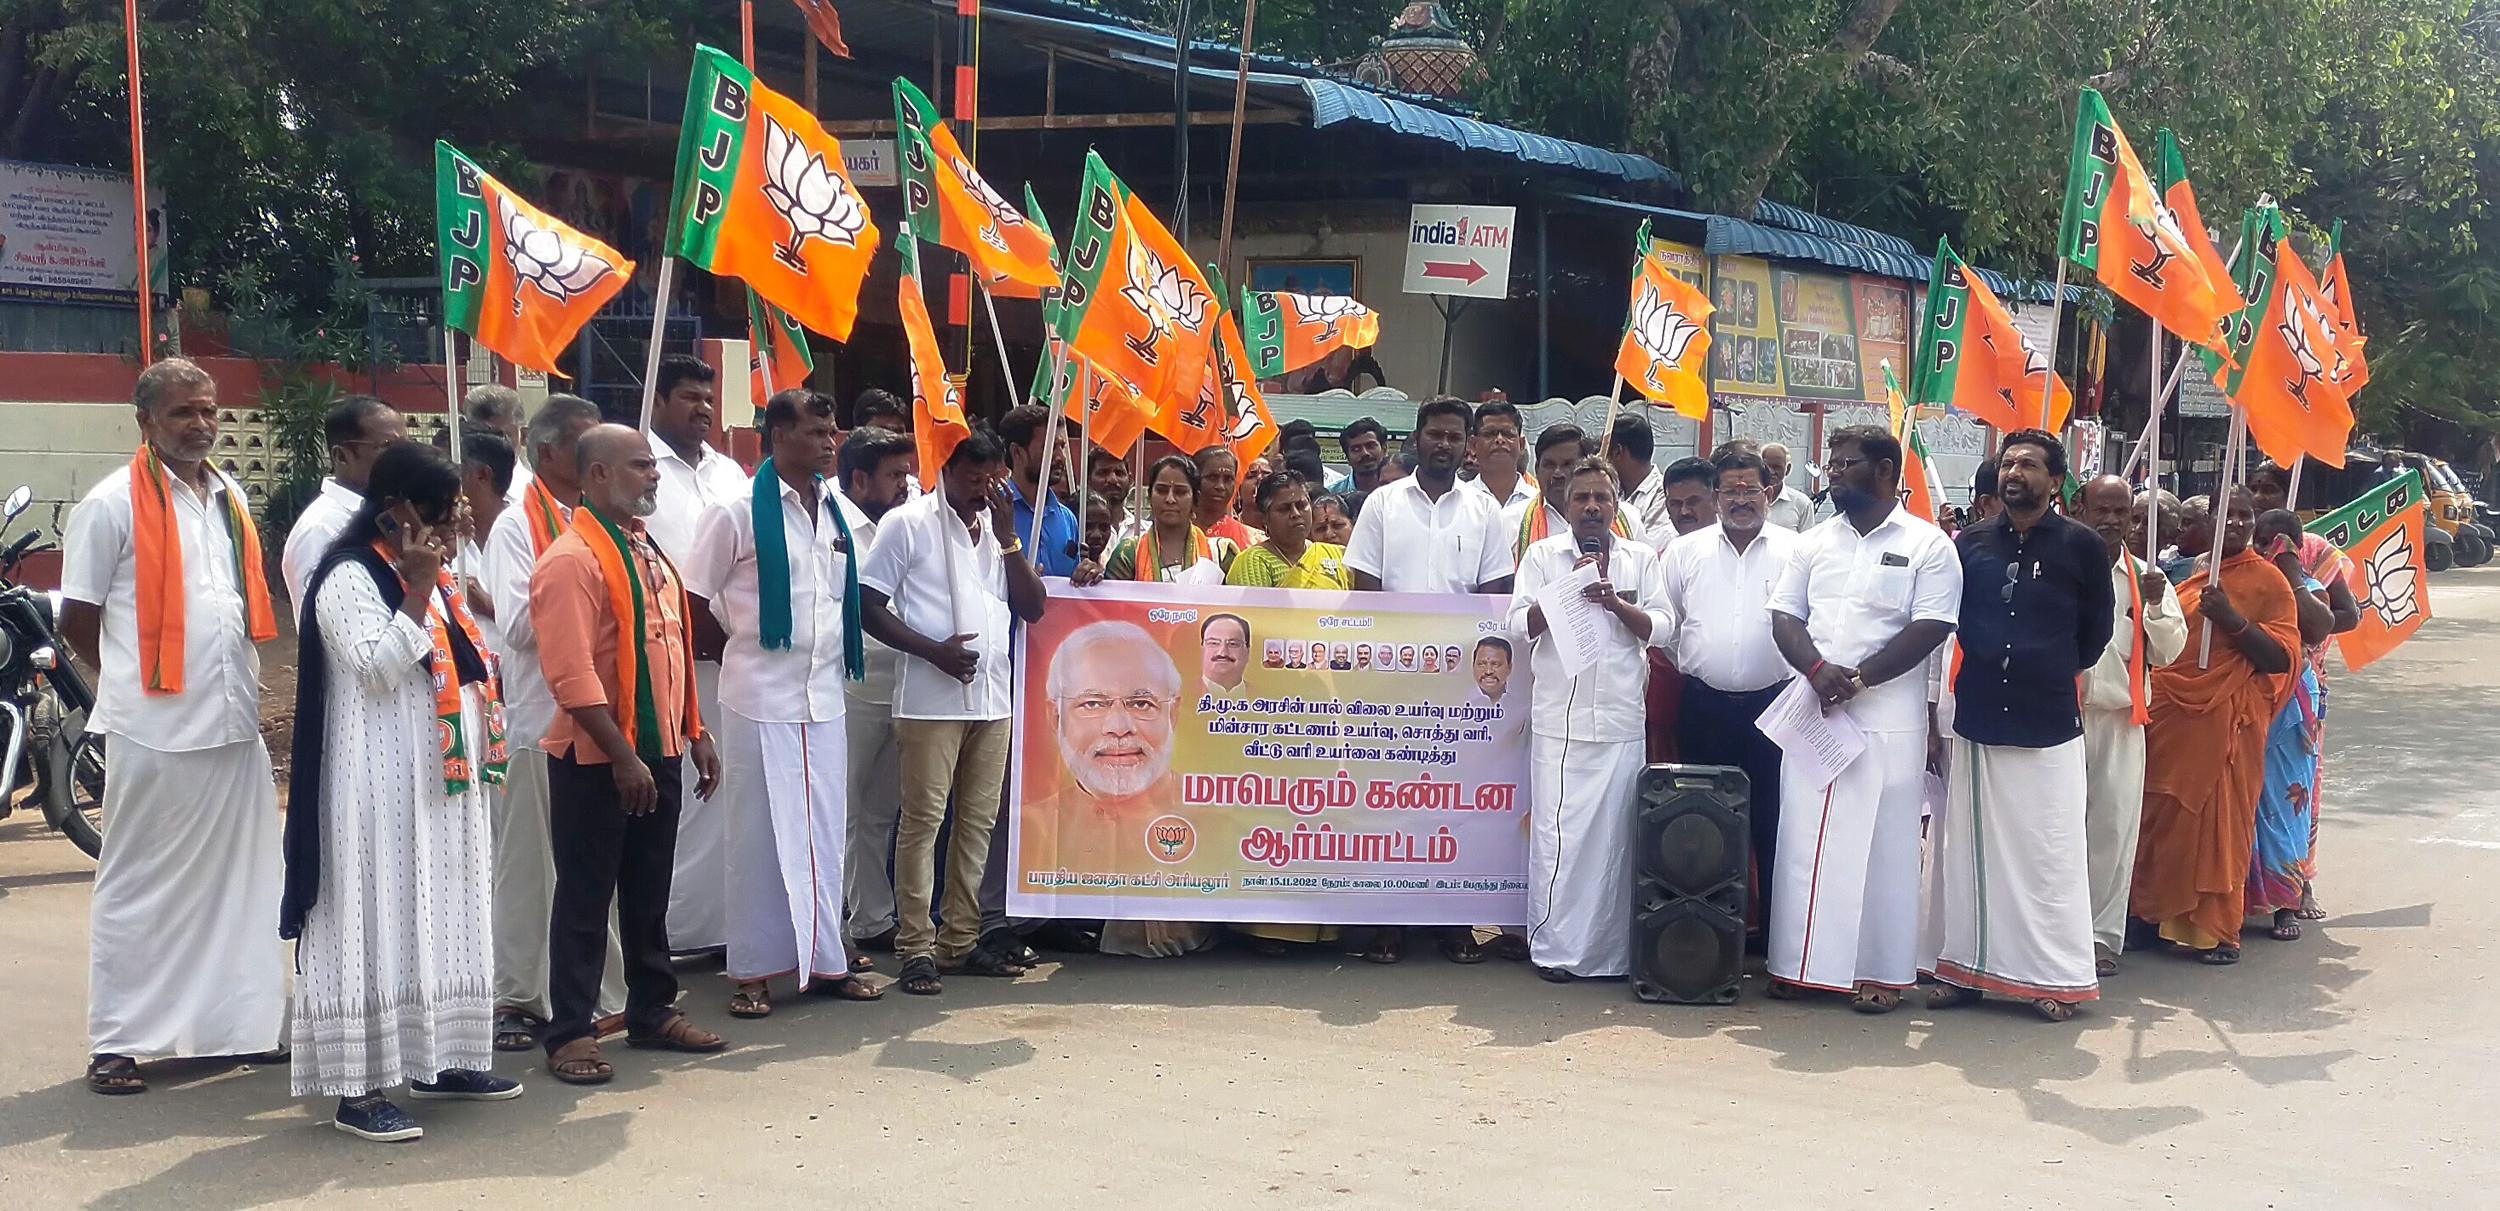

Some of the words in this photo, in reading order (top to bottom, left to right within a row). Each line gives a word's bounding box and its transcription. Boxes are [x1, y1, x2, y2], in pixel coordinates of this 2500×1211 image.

[692, 71, 748, 225] BJP
[844, 149, 880, 171] யகர்
[900, 91, 930, 215] BJP
[2079, 121, 2120, 256] BJP
[449, 154, 483, 291] BJP
[1470, 225, 1508, 248] ATM
[1061, 184, 1115, 310] BJP
[2234, 220, 2279, 349] BJP
[1255, 293, 1282, 368] BJP
[1933, 259, 1969, 372] BJP
[2325, 482, 2410, 549] BJP
[1149, 609, 1171, 622] ஒரே
[1172, 610, 1198, 623] நாடு!
[1318, 615, 1340, 628] ஒரே
[1477, 620, 1499, 632] ஒரே
[1197, 696, 1249, 714] தி.மு.க
[1252, 697, 1306, 715] அரசின்
[1309, 698, 1342, 715] பால்
[1346, 700, 1391, 717] விலை
[1394, 700, 1445, 720] உயர்வு
[1448, 701, 1505, 723] மற்றும்
[1208, 717, 1269, 736] மின்சார
[1271, 719, 1340, 738] கட்டணம்
[1343, 721, 1399, 741] உயர்வு,
[1401, 723, 1460, 743] சொத்து
[1462, 725, 1493, 744] வரி,
[1243, 742, 1283, 759] வீட்டு
[1286, 743, 1312, 759] வரி
[1315, 743, 1381, 761] உயர்வை
[1384, 745, 1457, 766] கண்டித்து
[1183, 769, 1356, 816] மாபெரும்
[1364, 771, 1517, 812] கண்டன
[1240, 822, 1459, 868] ஆர்ப்பாட்டம்
[1027, 868, 1079, 887] பாரதிய
[1080, 871, 1127, 888] ஜனதா
[1130, 870, 1161, 887] கட்சி
[1164, 872, 1230, 893] அரியலூர்
[1269, 877, 1317, 887] 15.11.2022
[1351, 879, 1382, 889] காலை
[1462, 880, 1498, 892] பேருந்து
[1499, 879, 1529, 892] நிலைய
